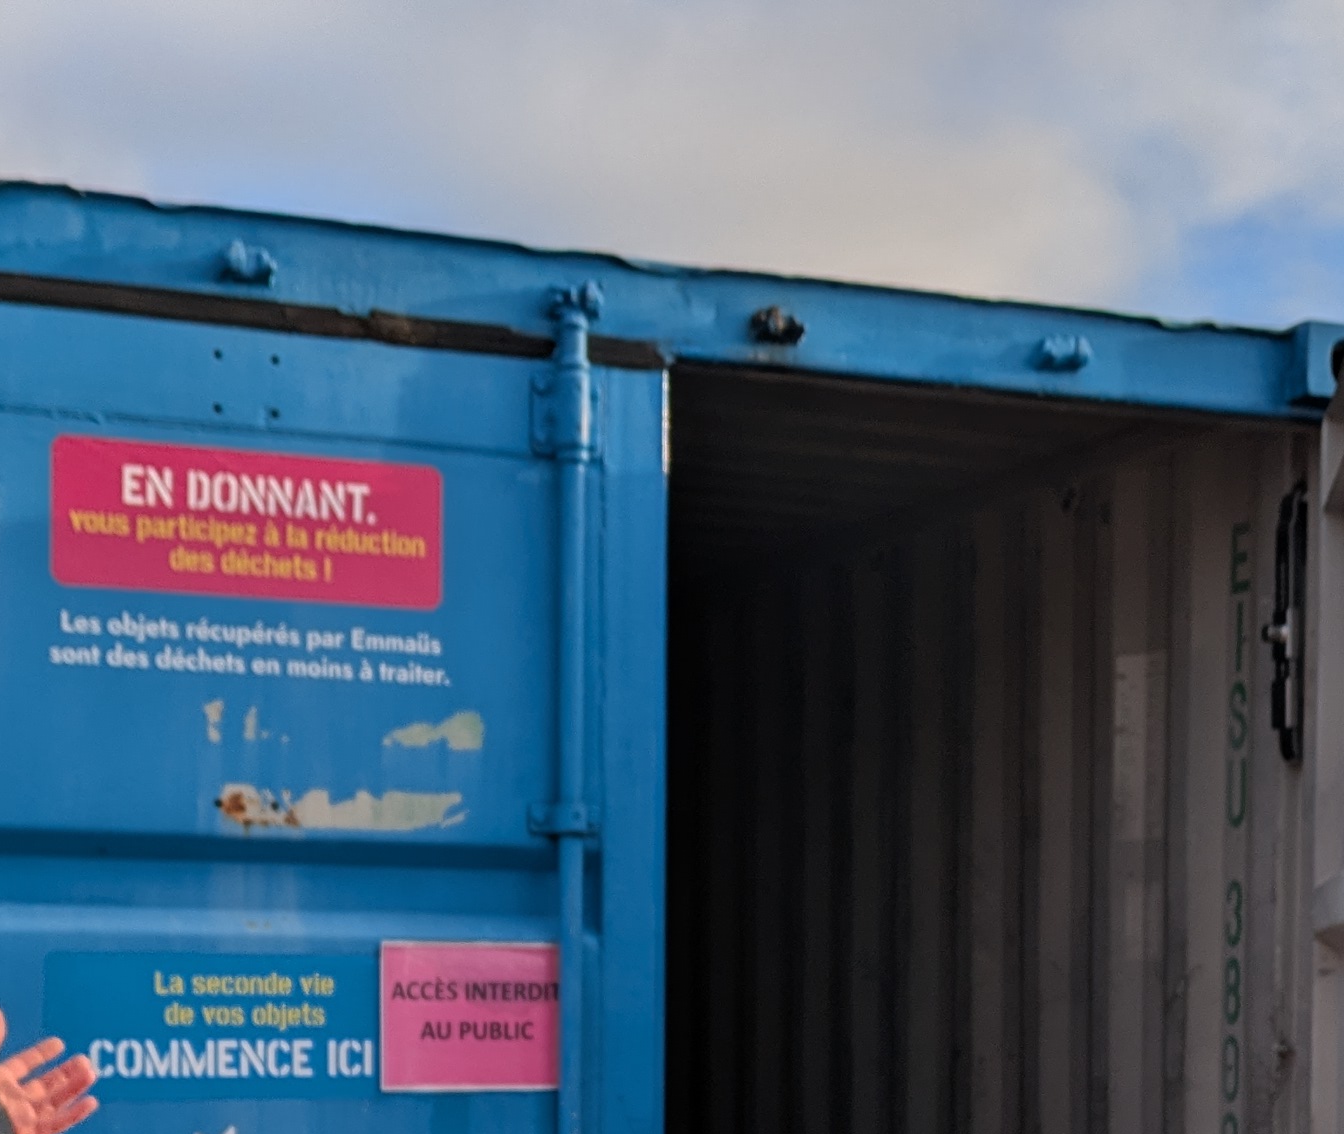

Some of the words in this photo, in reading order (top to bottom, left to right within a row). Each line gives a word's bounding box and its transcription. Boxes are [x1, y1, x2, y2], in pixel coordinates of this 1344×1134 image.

[122, 464, 174, 508] EN
[68, 509, 131, 537] vous
[135, 513, 257, 549] participez
[263, 519, 280, 548] à
[286, 522, 308, 549] la
[314, 524, 426, 559] réduction
[169, 546, 215, 574] des
[220, 549, 317, 581] déchets
[323, 556, 333, 583] !
[60, 608, 102, 635] Les
[107, 610, 180, 643] objets
[185, 617, 301, 649] récupérés
[307, 629, 344, 655] par
[351, 627, 442, 656] Emmaüs
[49, 644, 100, 666] sont
[106, 641, 149, 669] des
[154, 644, 246, 675] déchets
[251, 657, 281, 677] en
[287, 656, 354, 681] moins
[359, 658, 374, 682] à
[379, 660, 452, 687] traiter.
[154, 971, 184, 996] La
[192, 972, 292, 996] seconde
[301, 973, 335, 996] vie
[392, 977, 458, 1001] ACCÈS
[164, 1002, 194, 1026] de
[201, 1005, 245, 1026] vos
[251, 1002, 327, 1031] objets
[420, 1021, 453, 1041] AU
[459, 1021, 535, 1041] PUBLIC
[88, 1038, 314, 1078] COMMENCE
[327, 1038, 374, 1077] ICI
